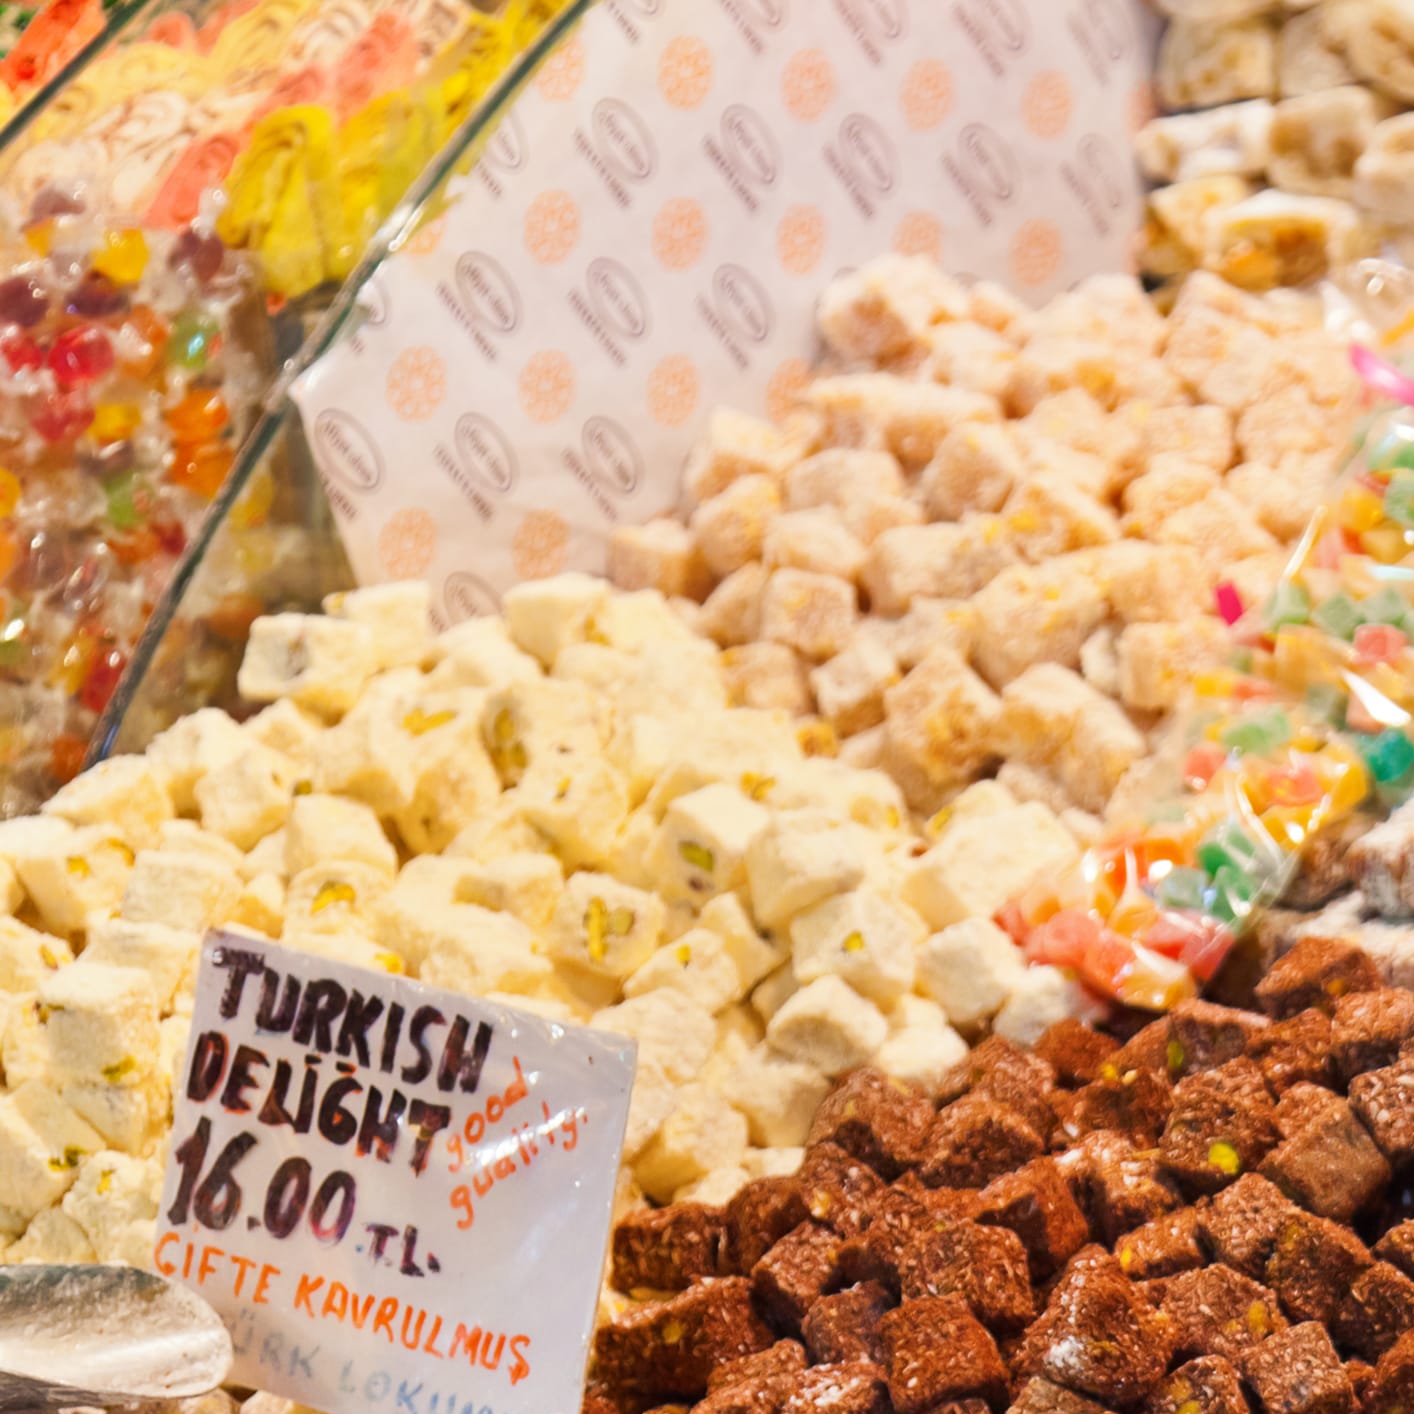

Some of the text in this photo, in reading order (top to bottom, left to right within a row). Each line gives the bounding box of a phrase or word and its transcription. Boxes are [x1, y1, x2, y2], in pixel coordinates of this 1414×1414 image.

[212, 946, 493, 1094] TURKISH
[447, 1055, 529, 1173] good
[220, 1306, 321, 1379] ÜRK
